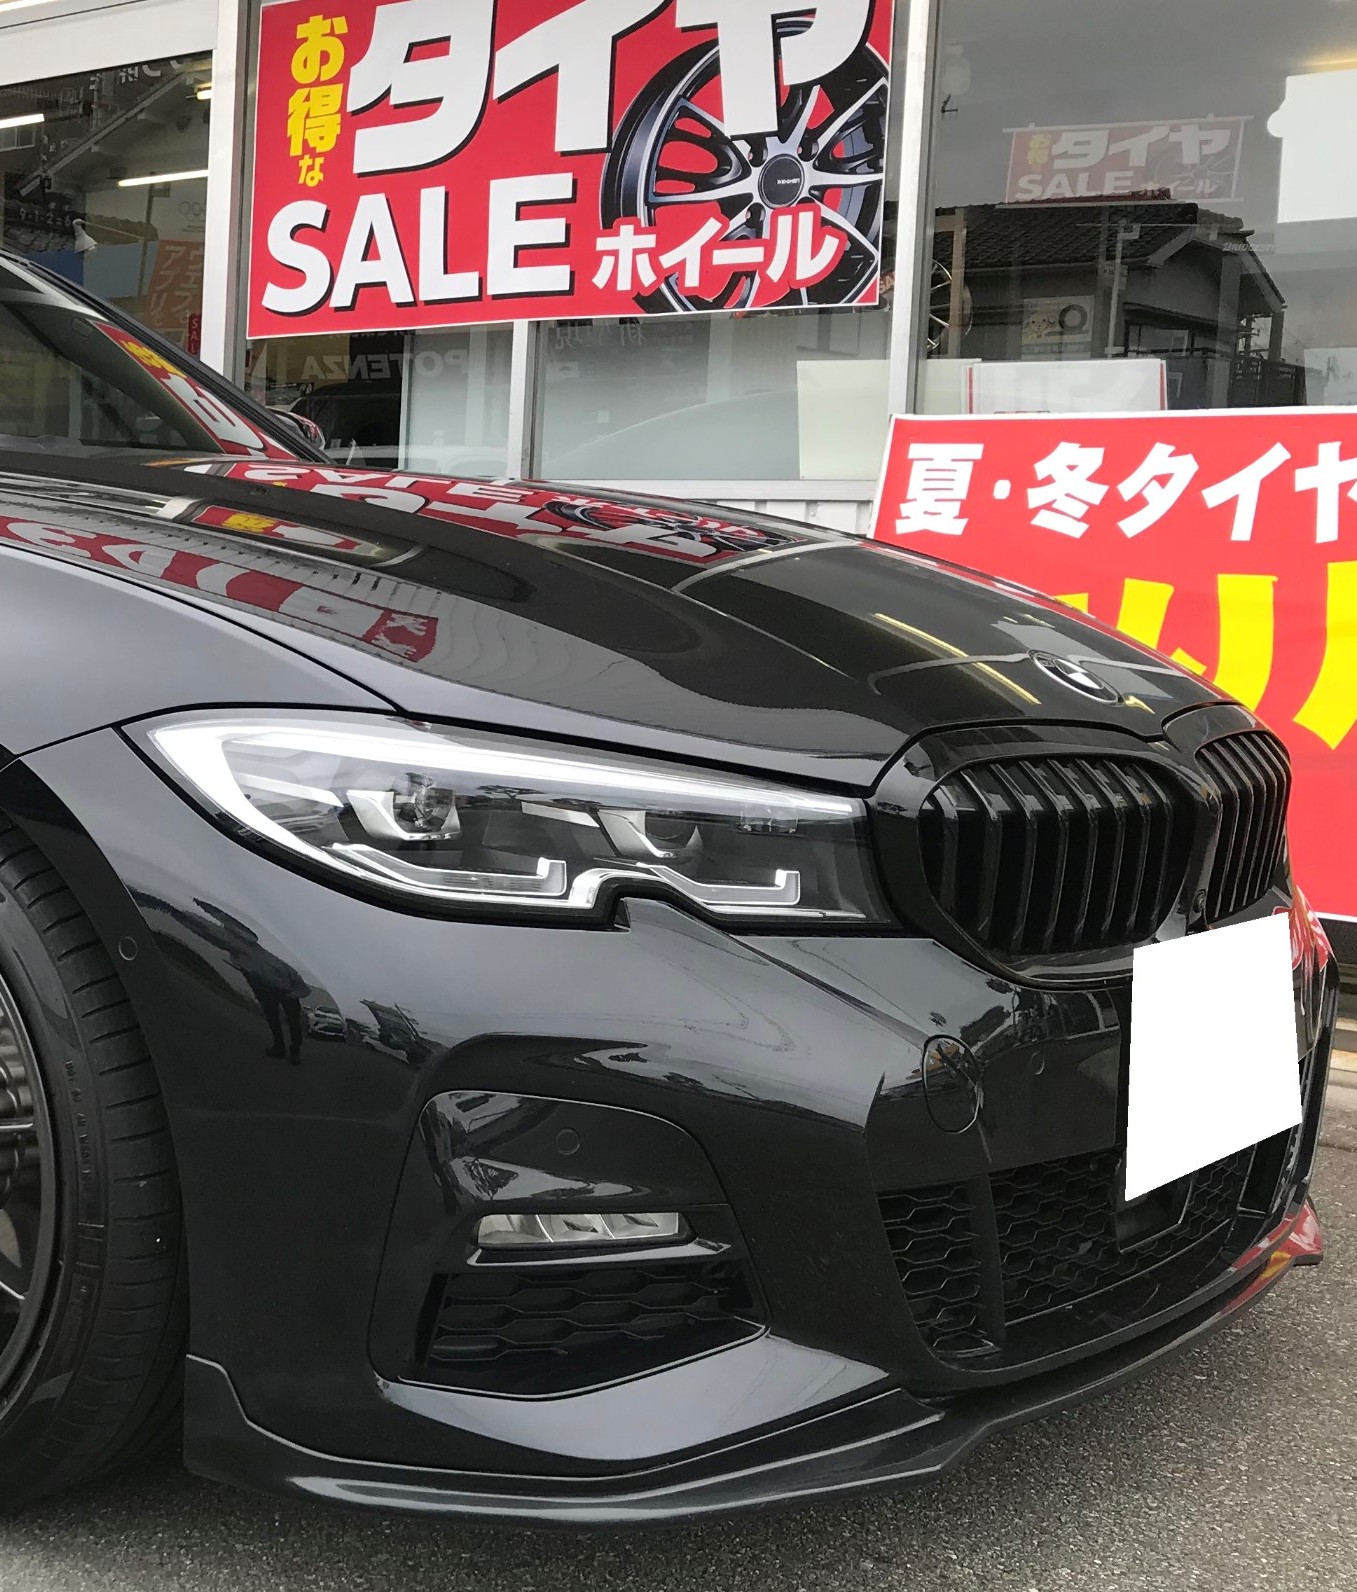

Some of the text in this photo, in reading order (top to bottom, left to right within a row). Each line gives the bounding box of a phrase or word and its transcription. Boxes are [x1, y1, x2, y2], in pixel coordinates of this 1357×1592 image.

[287, 14, 347, 188] お得な
[347, 0, 872, 174] タイヤ
[262, 172, 574, 314] SALE
[592, 210, 839, 292] ホイール
